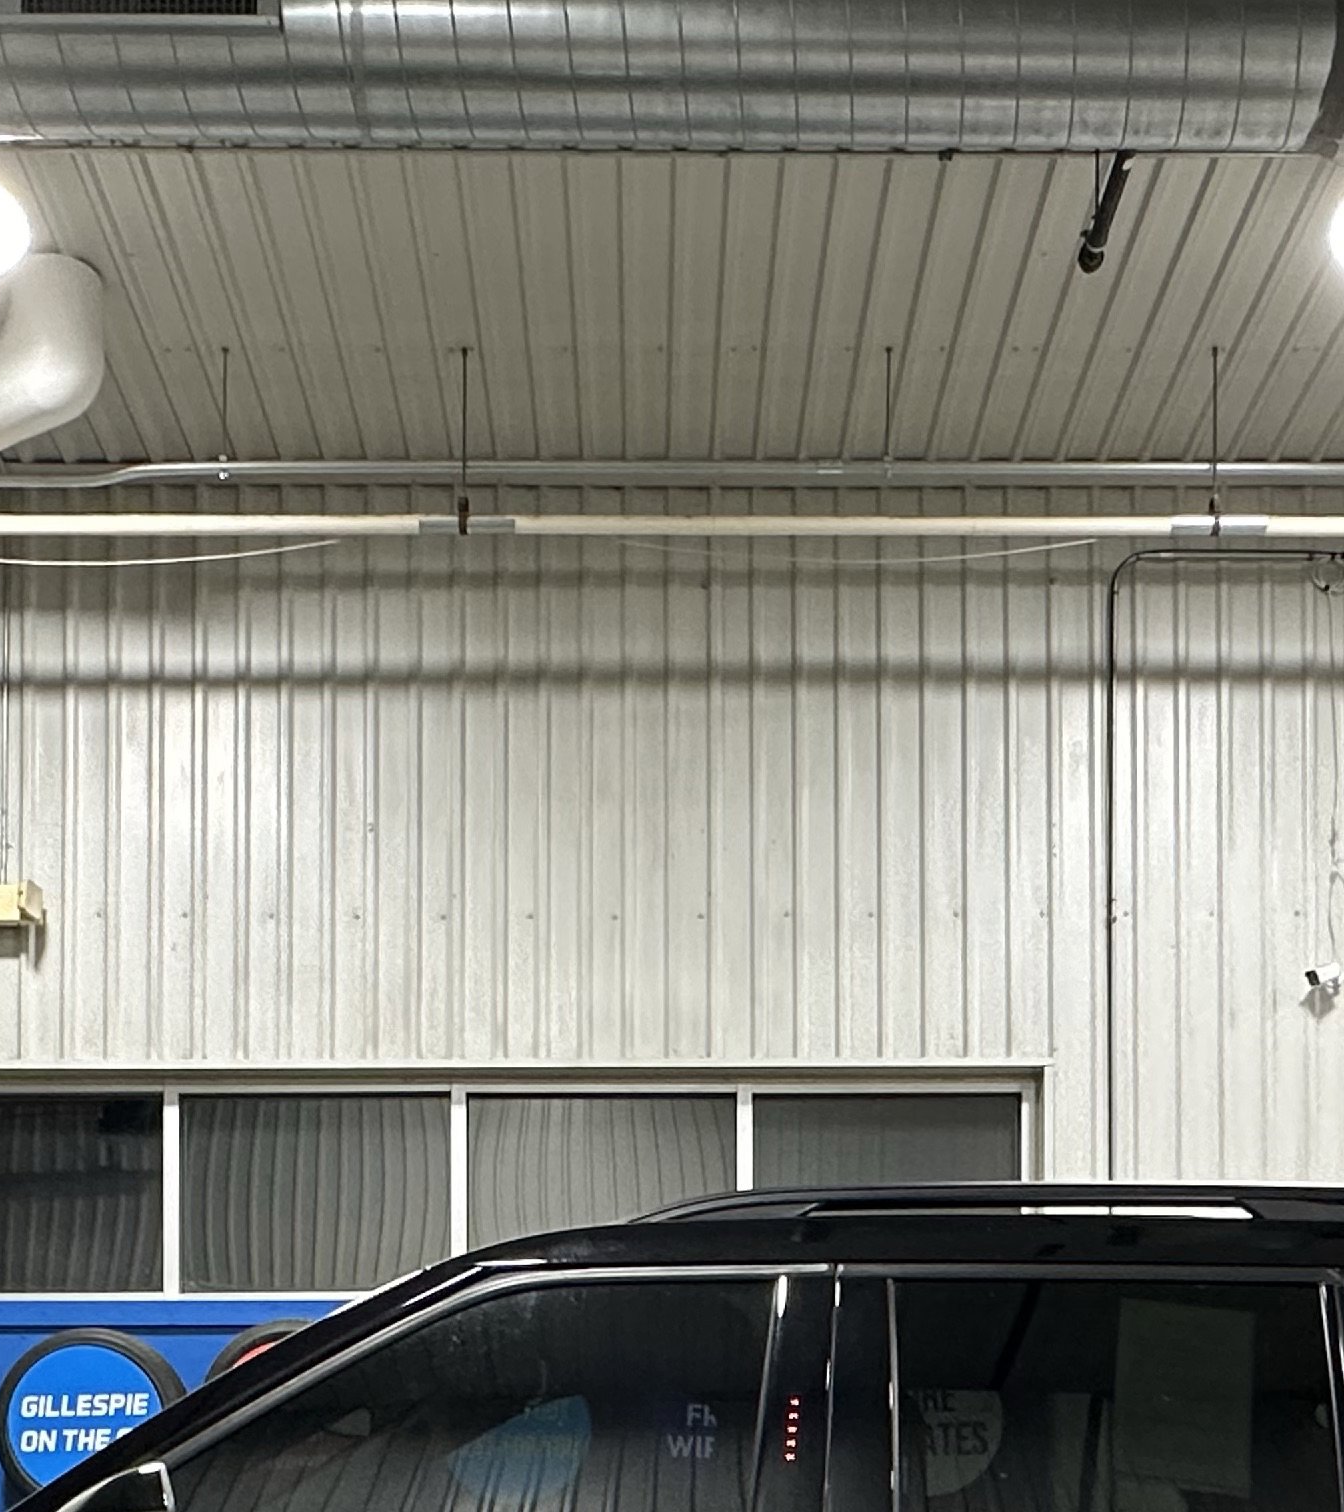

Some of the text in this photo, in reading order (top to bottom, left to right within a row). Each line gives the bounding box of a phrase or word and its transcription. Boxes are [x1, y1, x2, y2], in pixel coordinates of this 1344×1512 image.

[20, 1393, 149, 1418] GILLESPIE
[20, 1429, 58, 1453] ON
[62, 1428, 111, 1452] THE
